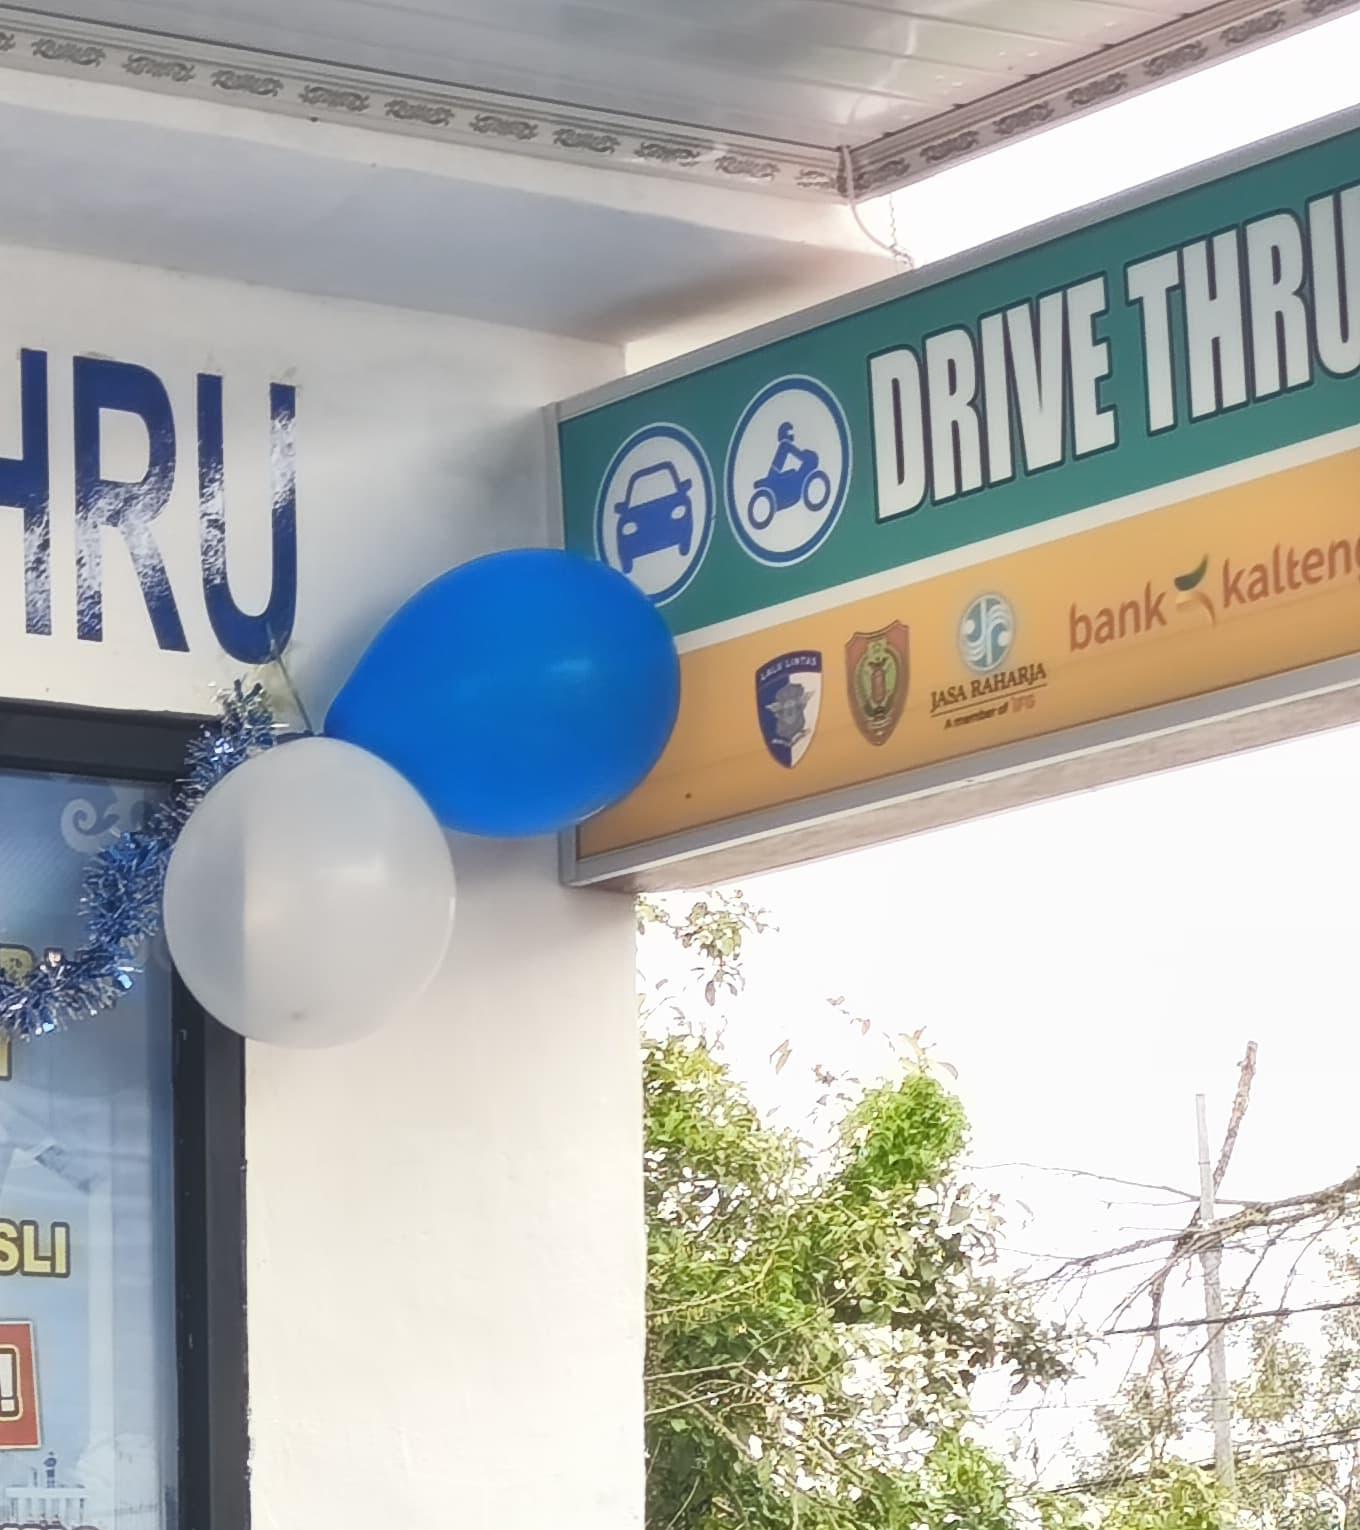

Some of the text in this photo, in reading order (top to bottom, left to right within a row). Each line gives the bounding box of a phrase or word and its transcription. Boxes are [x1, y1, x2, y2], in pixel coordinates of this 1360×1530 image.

[868, 180, 1360, 523] DRIVE THRU
[1068, 580, 1168, 652] bank
[930, 662, 1047, 713] JASA RAHARJA
